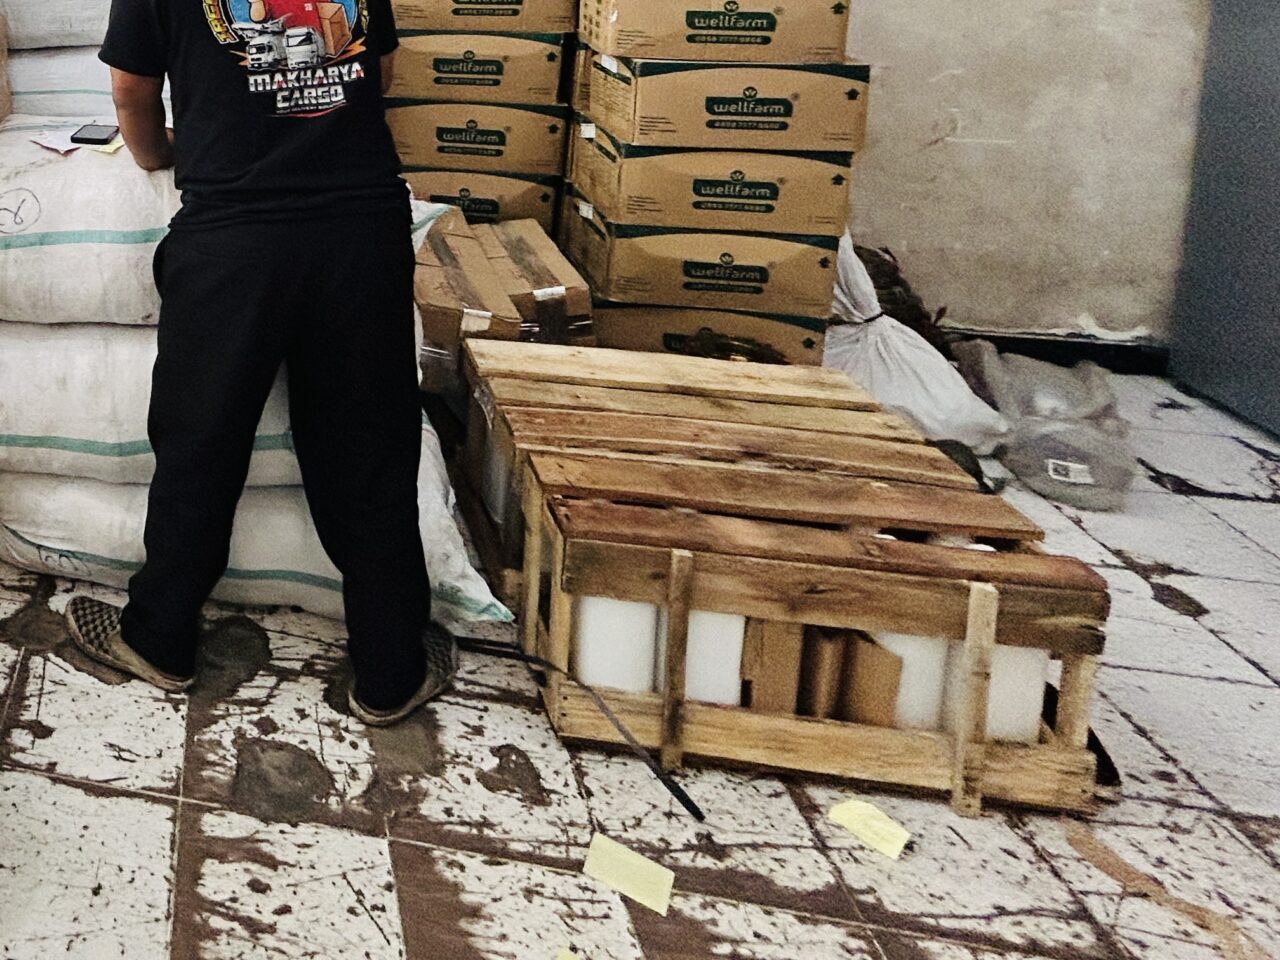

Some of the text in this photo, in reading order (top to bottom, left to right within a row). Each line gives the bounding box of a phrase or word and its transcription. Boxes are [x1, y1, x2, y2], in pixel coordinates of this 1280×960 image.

[694, 15, 768, 28] wellfarm
[440, 62, 497, 73] wellfarm
[248, 61, 365, 92] MAKHARYA
[276, 85, 345, 108] CARGO
[713, 101, 785, 114] wellfarm
[442, 131, 499, 143] wellfarm
[701, 184, 771, 197] wellfarm
[691, 267, 761, 280] wellfarm
